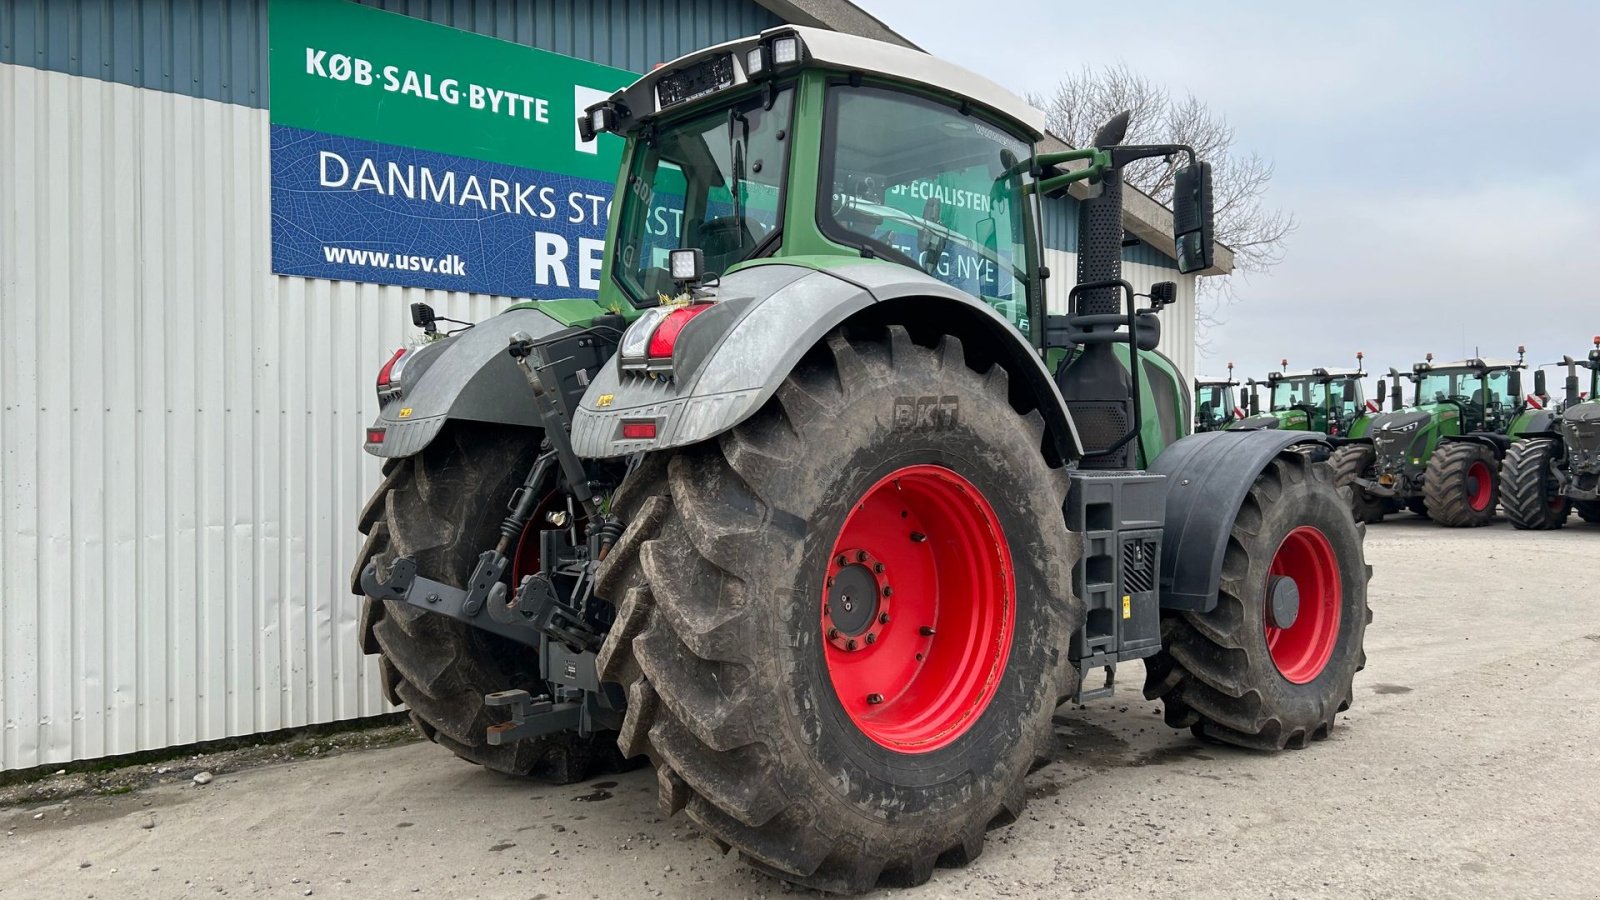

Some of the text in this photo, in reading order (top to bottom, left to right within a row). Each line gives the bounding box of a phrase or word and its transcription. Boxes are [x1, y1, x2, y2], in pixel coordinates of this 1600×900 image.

[319, 150, 556, 219] DANMARKS
[323, 246, 466, 276] www.usv.dk
[957, 254, 995, 283] NYE
[893, 398, 959, 428] BKT
